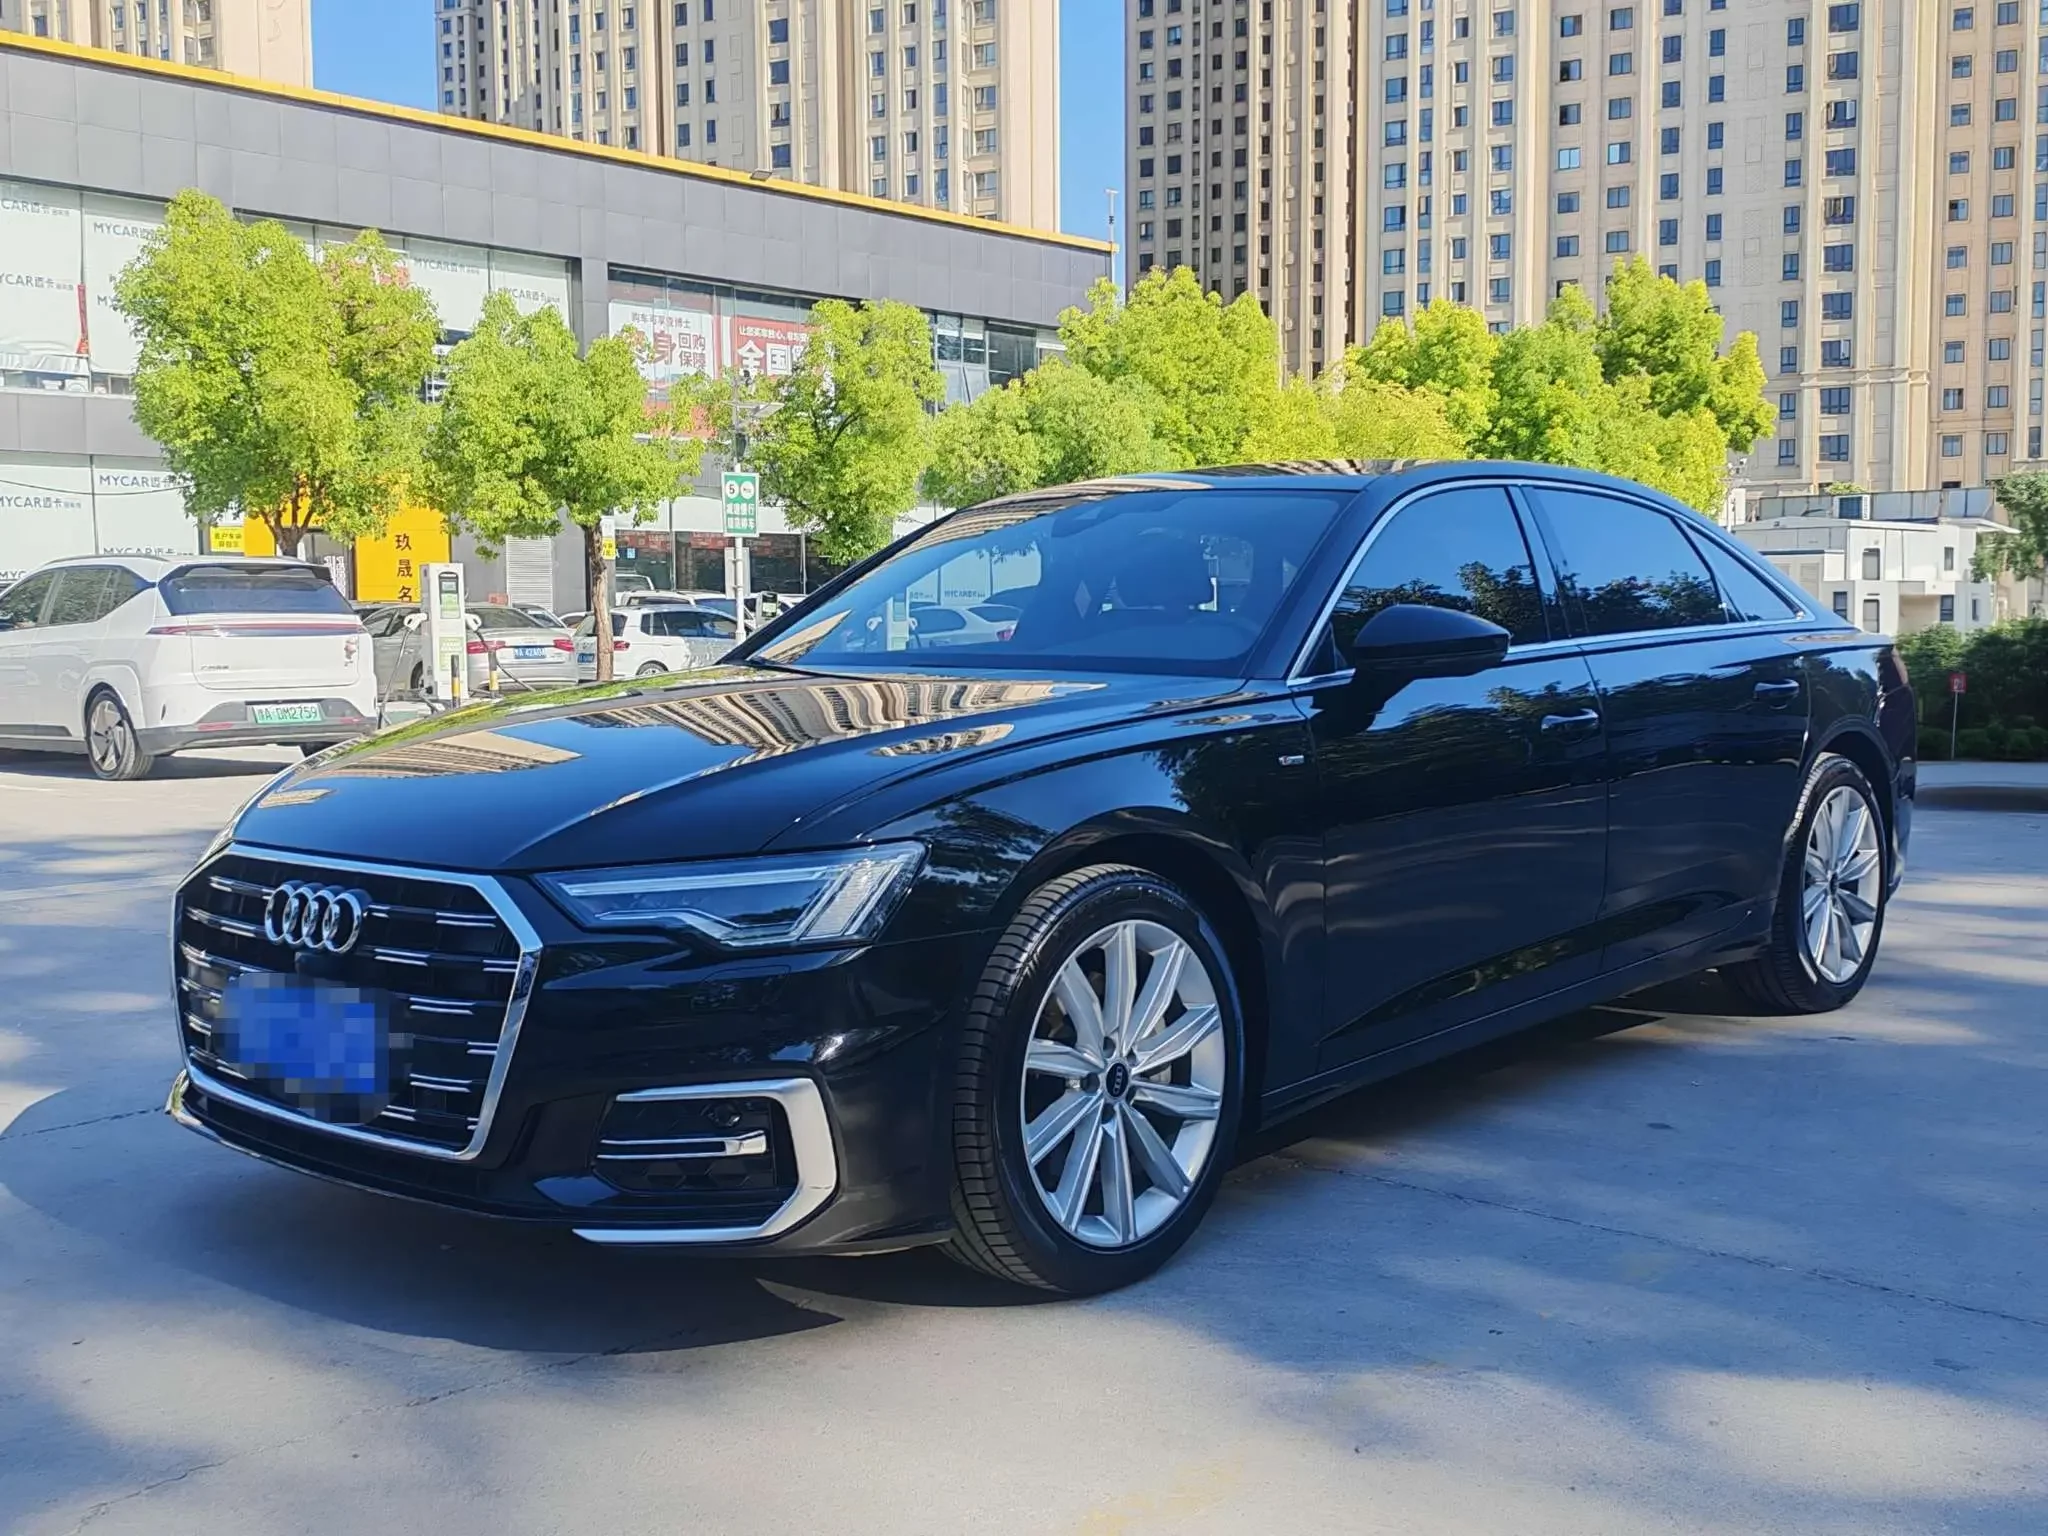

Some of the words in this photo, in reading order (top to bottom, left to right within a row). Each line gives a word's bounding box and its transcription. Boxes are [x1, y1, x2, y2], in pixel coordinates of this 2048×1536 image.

[679, 332, 706, 351] 回购
[679, 352, 707, 370] 保障
[729, 484, 735, 495] 5
